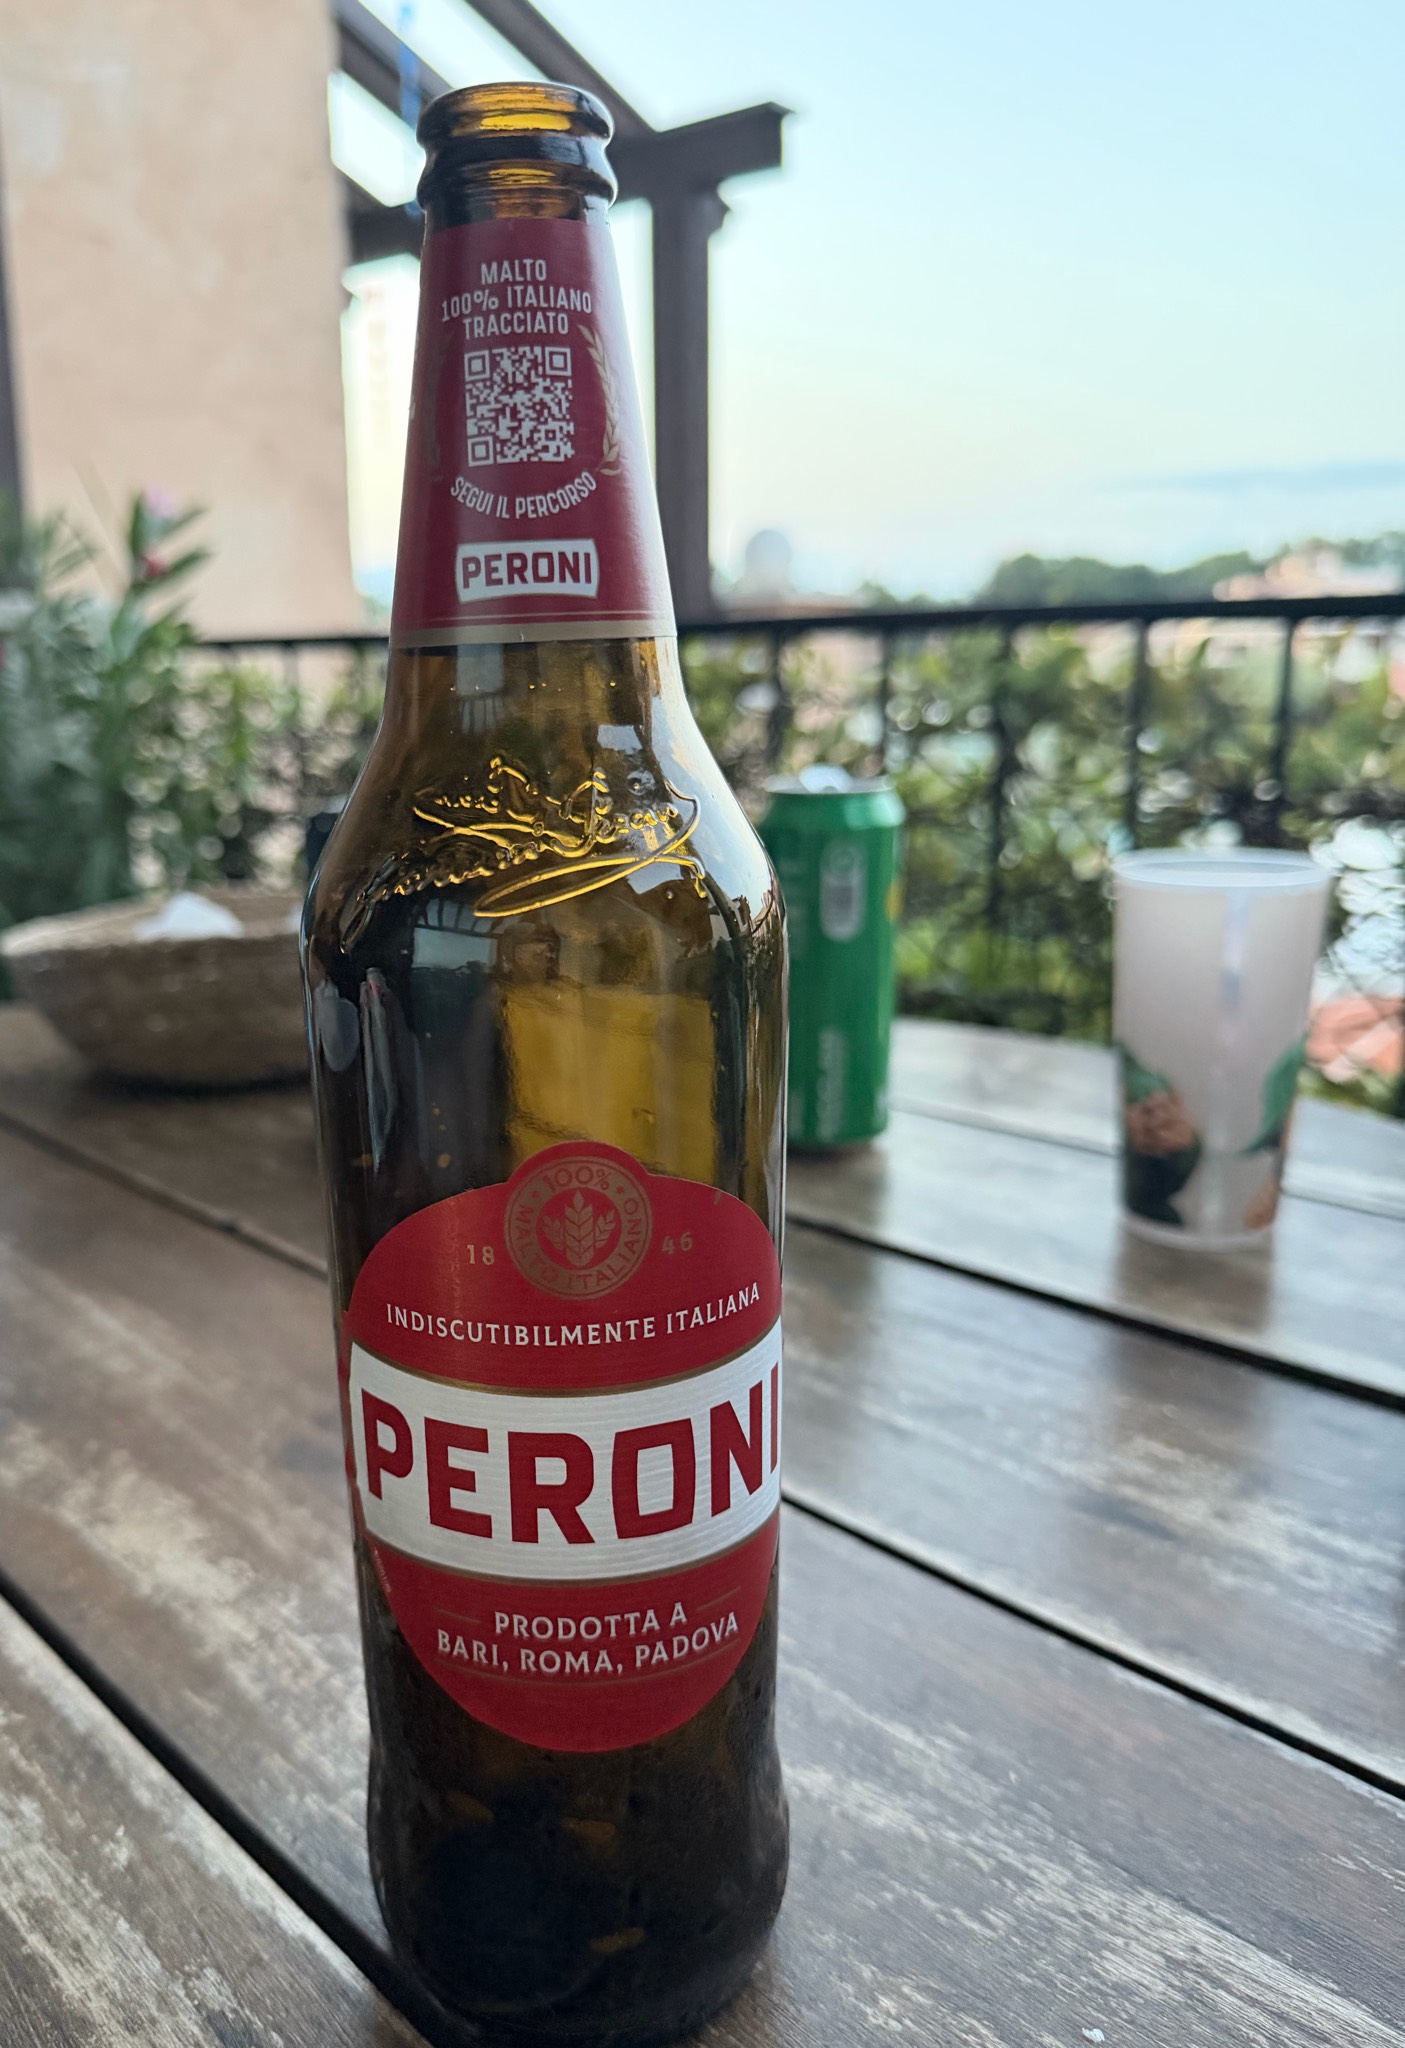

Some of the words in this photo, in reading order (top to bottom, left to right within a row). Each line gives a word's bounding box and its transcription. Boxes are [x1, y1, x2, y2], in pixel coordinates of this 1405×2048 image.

[481, 258, 547, 285] MALTO
[441, 289, 499, 322] 100%
[507, 286, 592, 314] ITALIANO
[463, 311, 569, 340] TRACCIATO
[450, 476, 494, 515] SEGUI
[496, 496, 510, 519] IL
[515, 471, 597, 519] PERCORSO
[462, 552, 592, 589] PERONI
[543, 1166, 612, 1192] 100%
[466, 1244, 495, 1265] 18
[661, 1231, 693, 1254] 46
[568, 1198, 642, 1289] ITALIANO
[387, 1304, 655, 1347] INDISCUTIBILMENTE
[667, 1282, 760, 1335] ITALIANA
[361, 1361, 779, 1544] PERONI
[495, 1609, 660, 1641] PRODOTTA
[669, 1602, 688, 1625] A
[437, 1629, 509, 1671] BARI,
[520, 1649, 623, 1675] ROMA,
[635, 1611, 739, 1667] PADOVA
